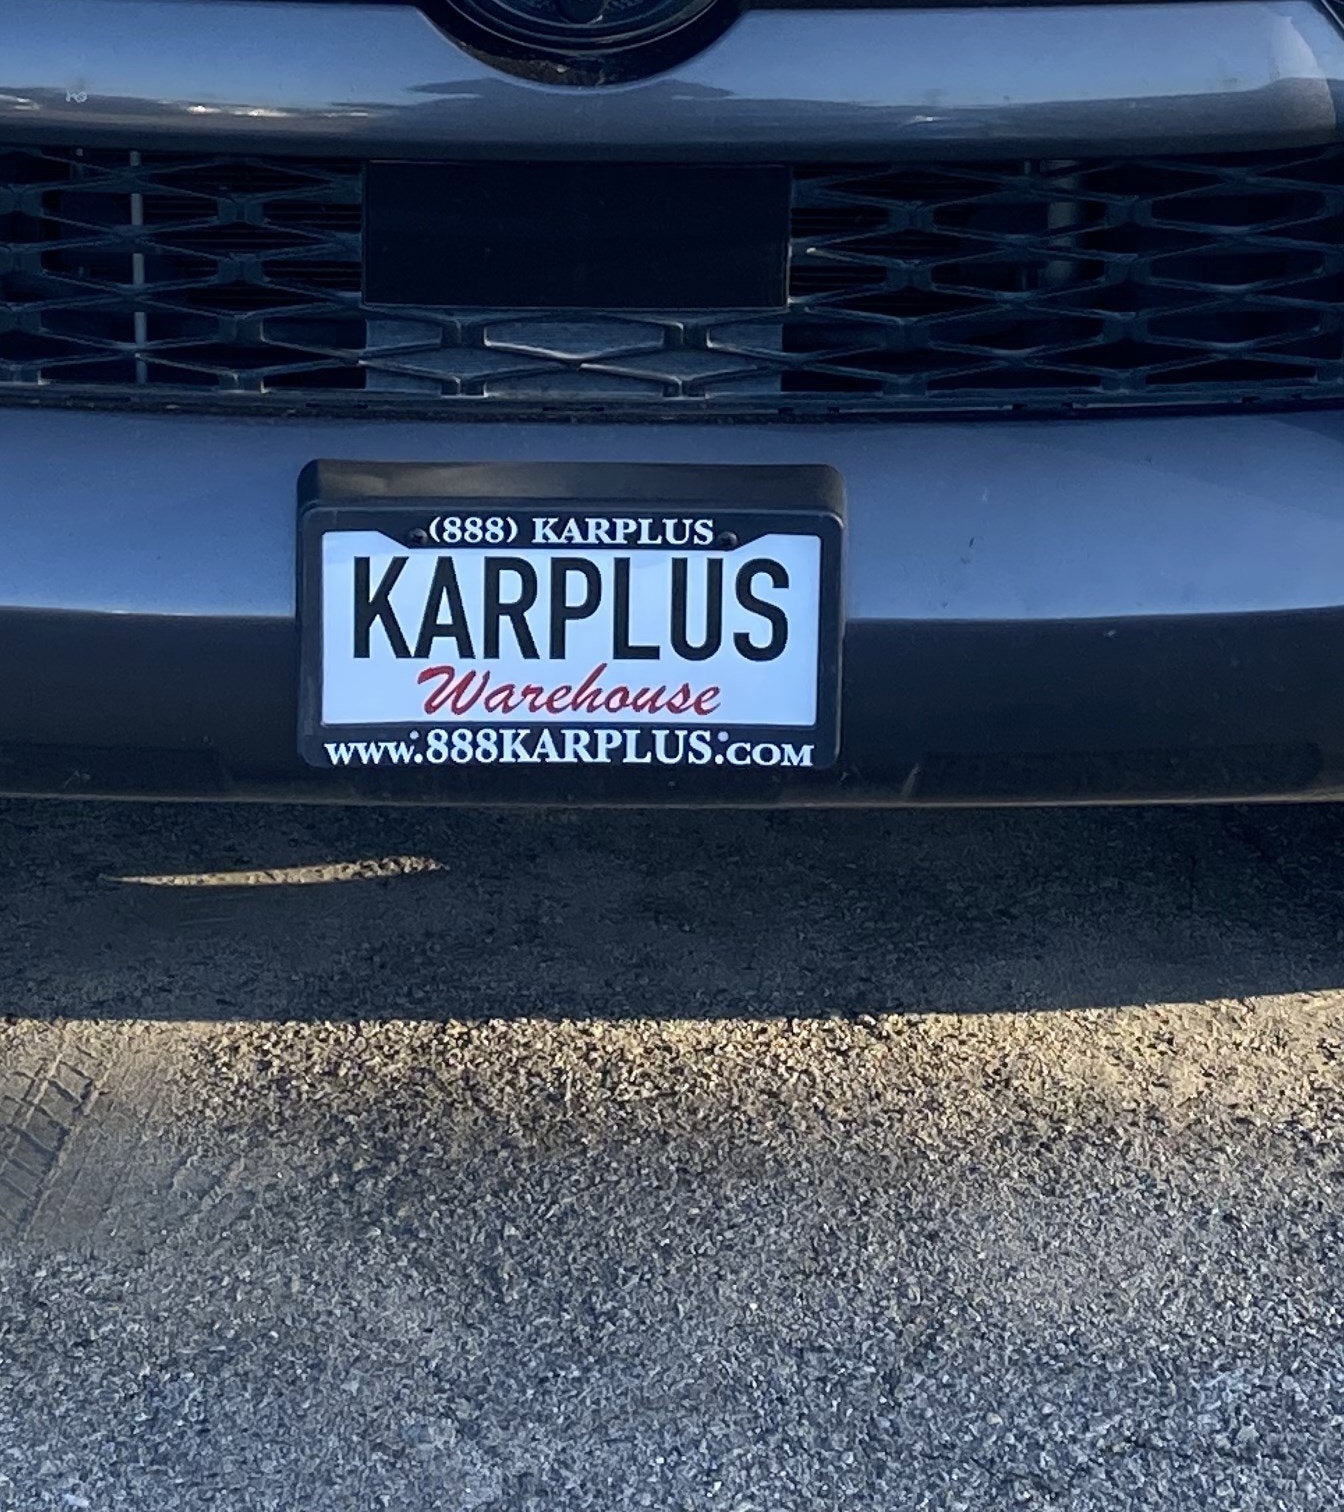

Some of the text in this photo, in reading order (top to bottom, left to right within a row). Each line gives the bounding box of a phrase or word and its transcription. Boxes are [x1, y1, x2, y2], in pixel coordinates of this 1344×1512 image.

[428, 516, 715, 546] (888) KARPLUS
[352, 555, 790, 662] KARPLUS
[416, 662, 722, 717] Warehouse
